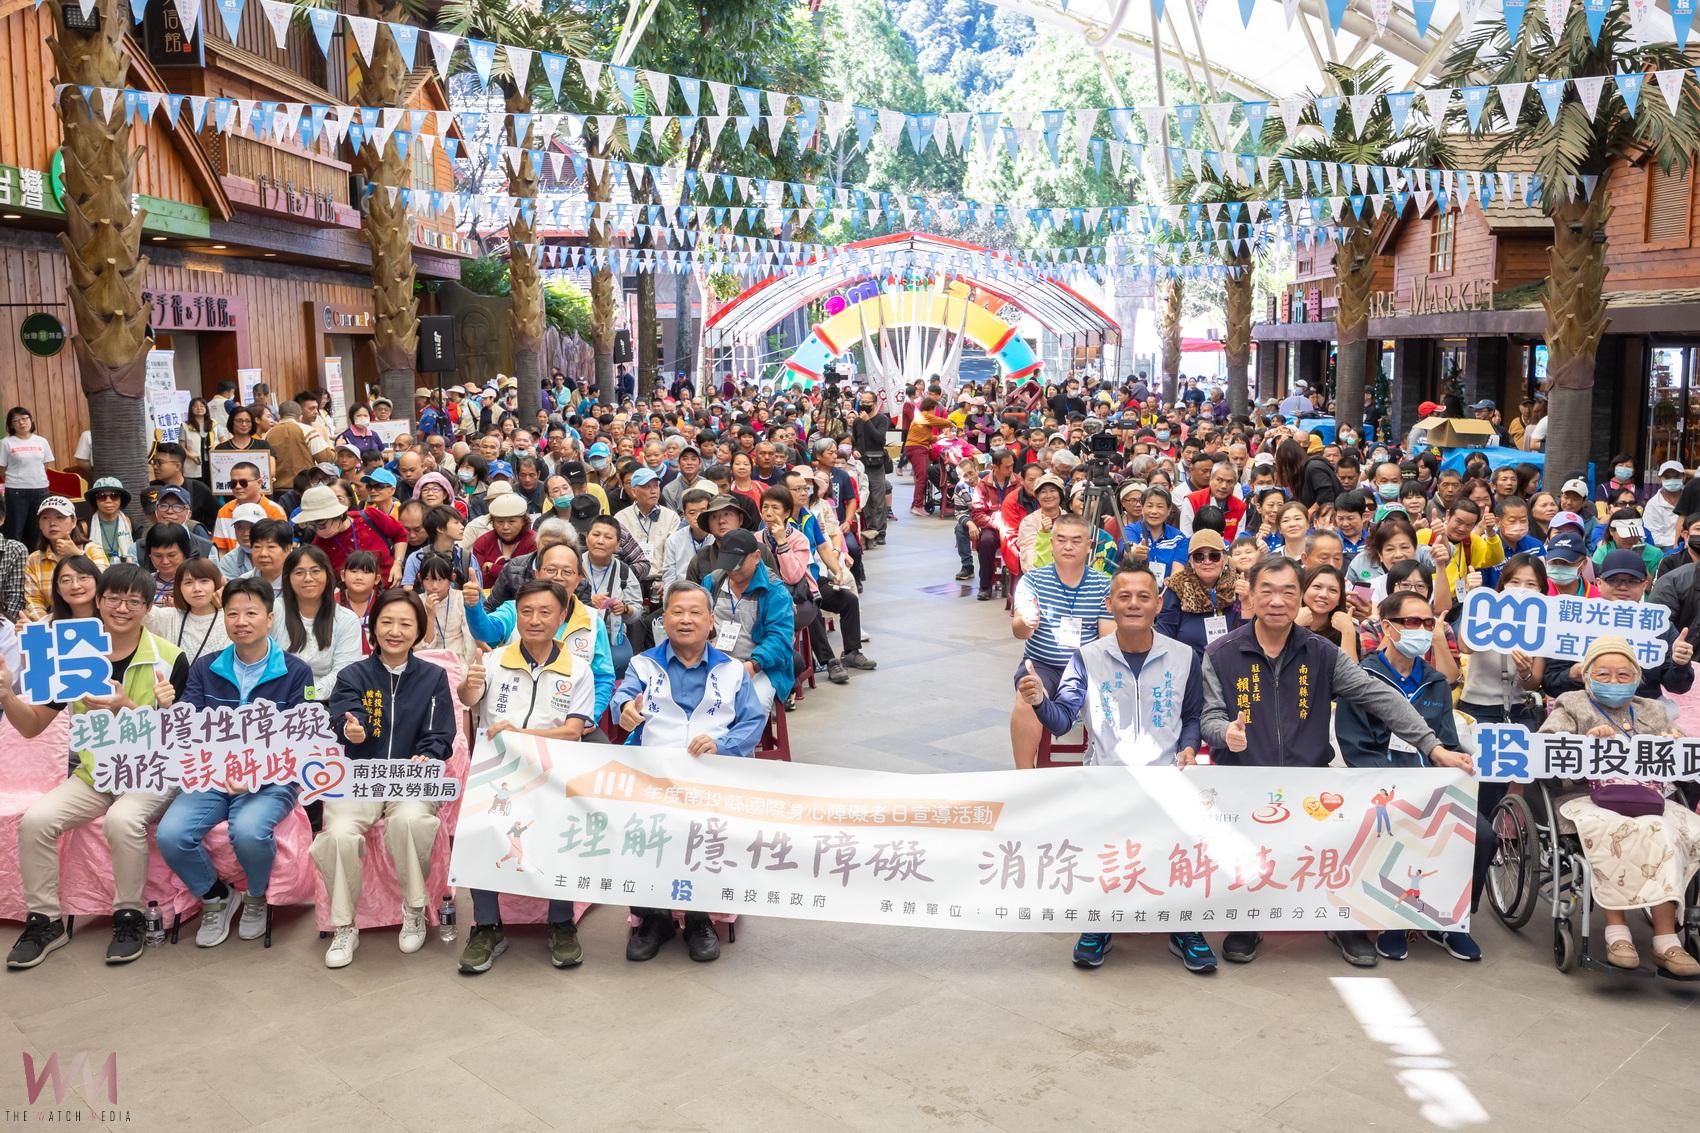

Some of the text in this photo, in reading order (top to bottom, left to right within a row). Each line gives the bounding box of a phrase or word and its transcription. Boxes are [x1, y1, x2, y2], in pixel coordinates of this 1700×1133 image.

[162, 0, 181, 53] 信館
[1409, 275, 1499, 315] MARKET
[1559, 600, 1665, 631] 觀光首都
[1555, 632, 1662, 664] 宜市
[495, 683, 510, 713] 林志忠
[1251, 664, 1260, 701] 駐區主任
[1299, 664, 1309, 719] 南投縣政府
[73, 702, 334, 750] 理解隱性障礙
[353, 764, 441, 780] 南投縣政府
[352, 782, 457, 798] 社會及勞動局
[557, 811, 935, 887] 理解隱性障礙
[721, 887, 826, 908] 南投縣政府
